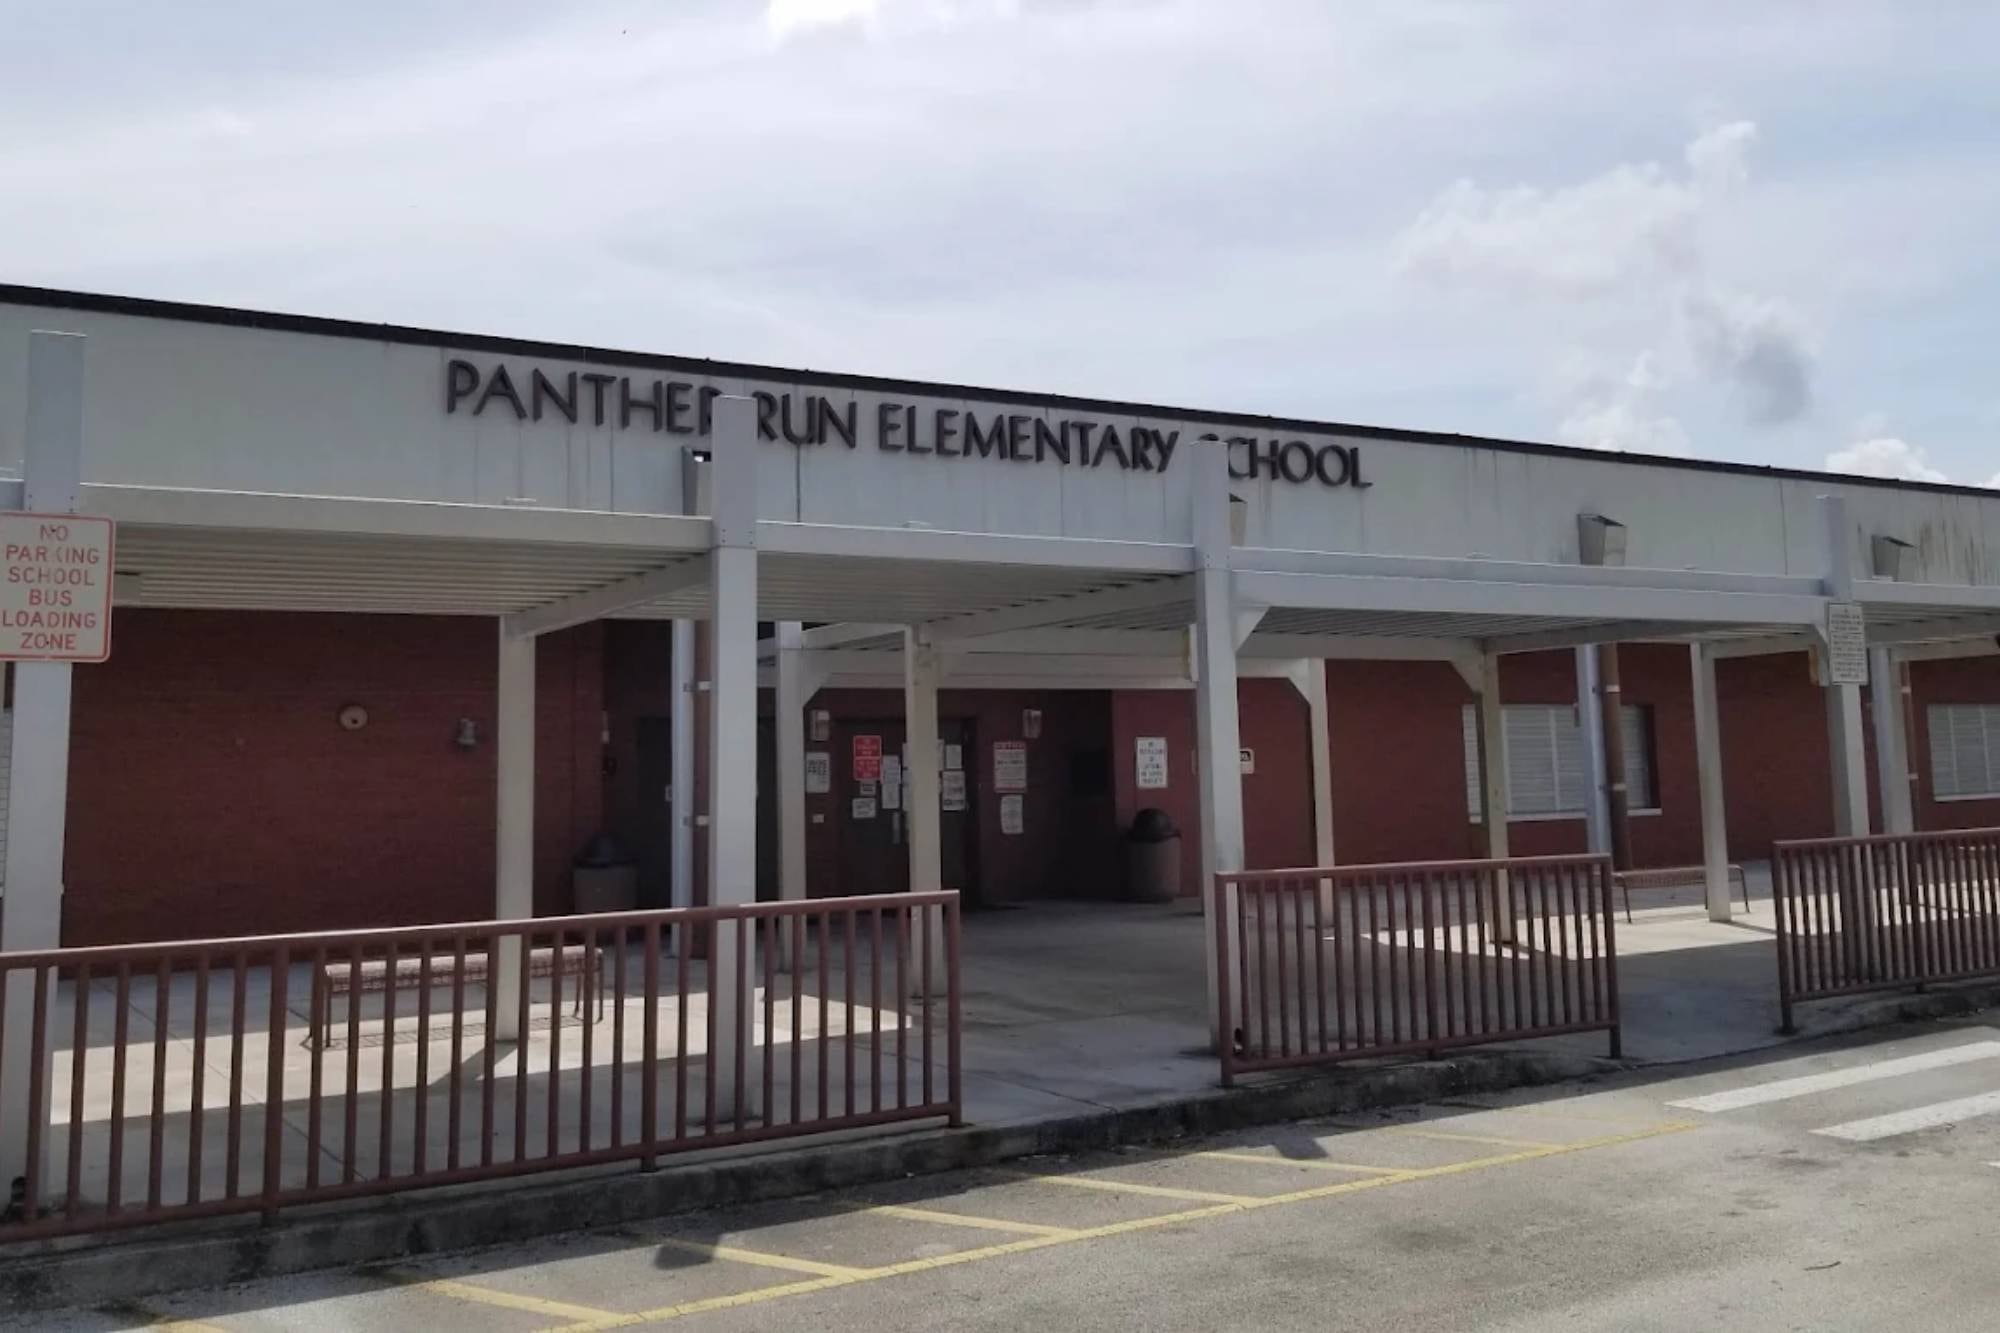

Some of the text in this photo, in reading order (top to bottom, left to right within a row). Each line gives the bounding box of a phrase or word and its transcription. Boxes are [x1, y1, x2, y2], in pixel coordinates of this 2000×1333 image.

[752, 391, 857, 449] RUN
[878, 402, 1180, 473] ELEMENTARY
[1199, 433, 1373, 488] CHOOL
[40, 524, 69, 541] NO
[8, 566, 94, 586] SCHOOL
[29, 588, 72, 607] BUS
[2, 609, 96, 628] LOADING
[20, 632, 76, 650] ZONE
